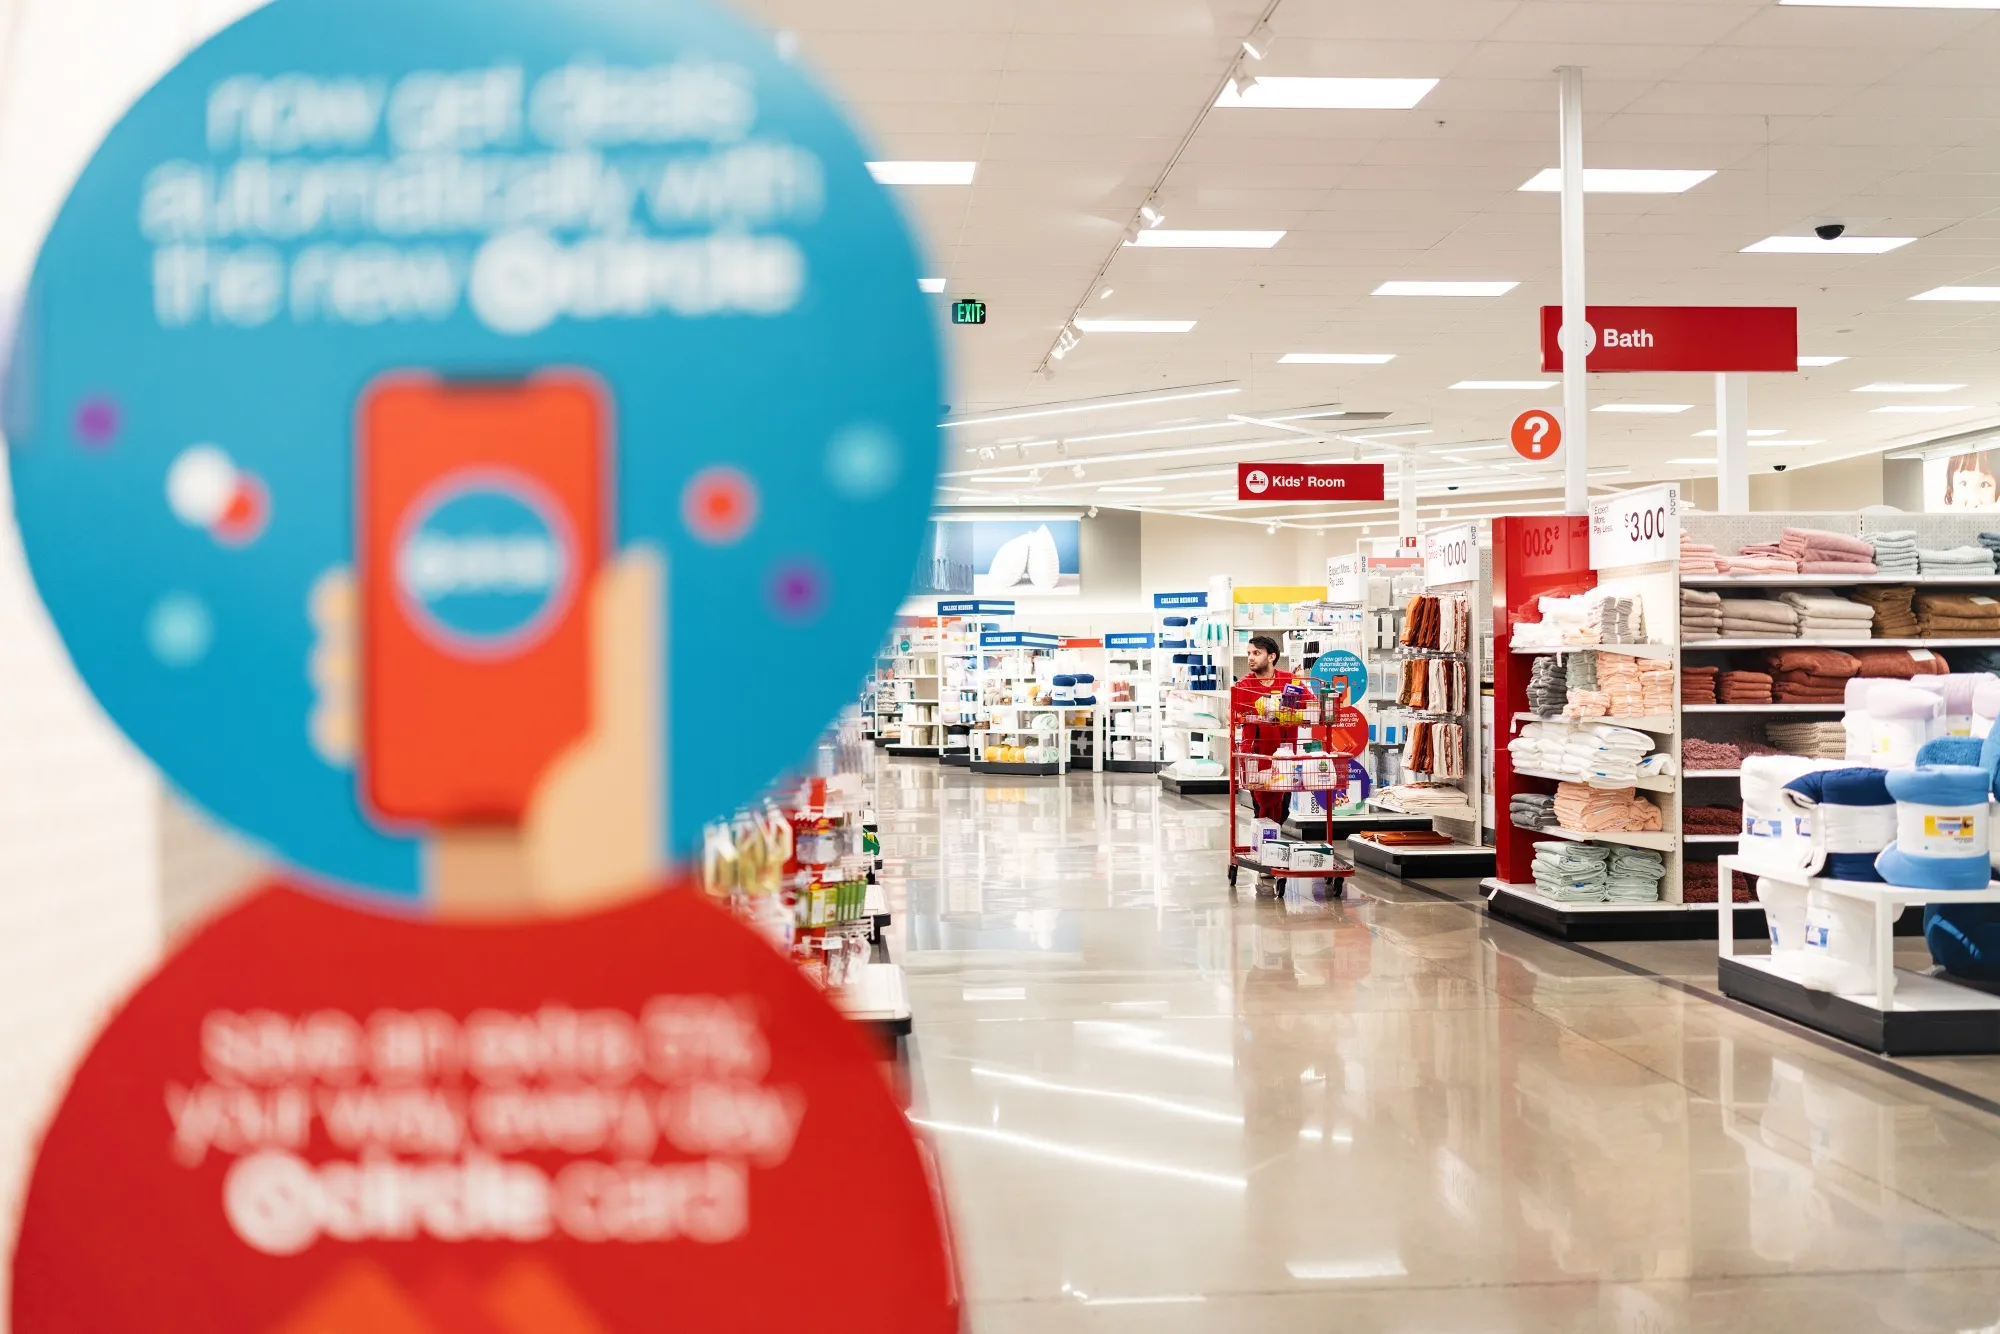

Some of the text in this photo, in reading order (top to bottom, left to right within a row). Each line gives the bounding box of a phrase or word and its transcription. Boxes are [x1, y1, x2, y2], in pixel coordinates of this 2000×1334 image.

[957, 303, 982, 323] EXIT
[1603, 328, 1654, 348] Bath
[1307, 475, 1346, 488] Room
